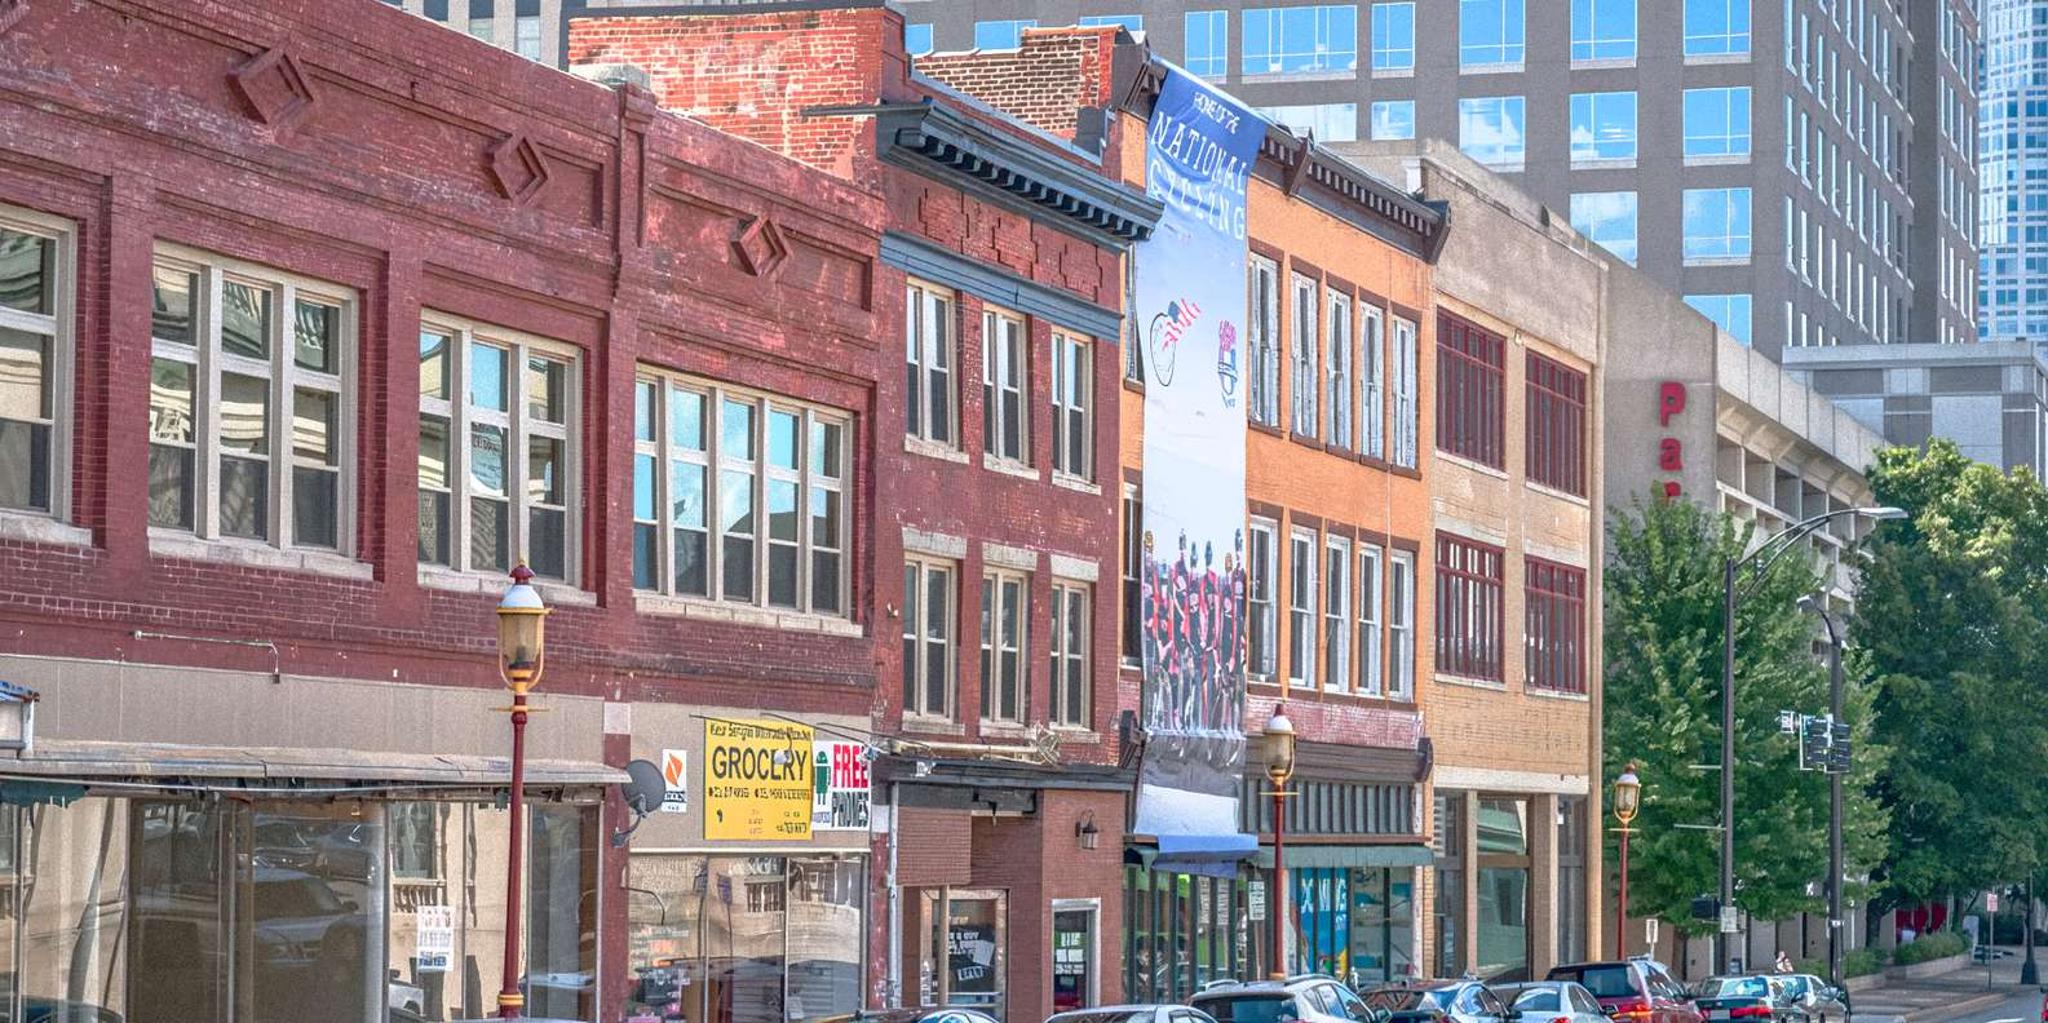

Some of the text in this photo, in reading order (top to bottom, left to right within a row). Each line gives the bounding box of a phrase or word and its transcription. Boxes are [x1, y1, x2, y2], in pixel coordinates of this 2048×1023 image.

[1151, 112, 1247, 195] NATIONAL
[712, 745, 808, 781] GROCERY
[833, 744, 869, 788] FREE
